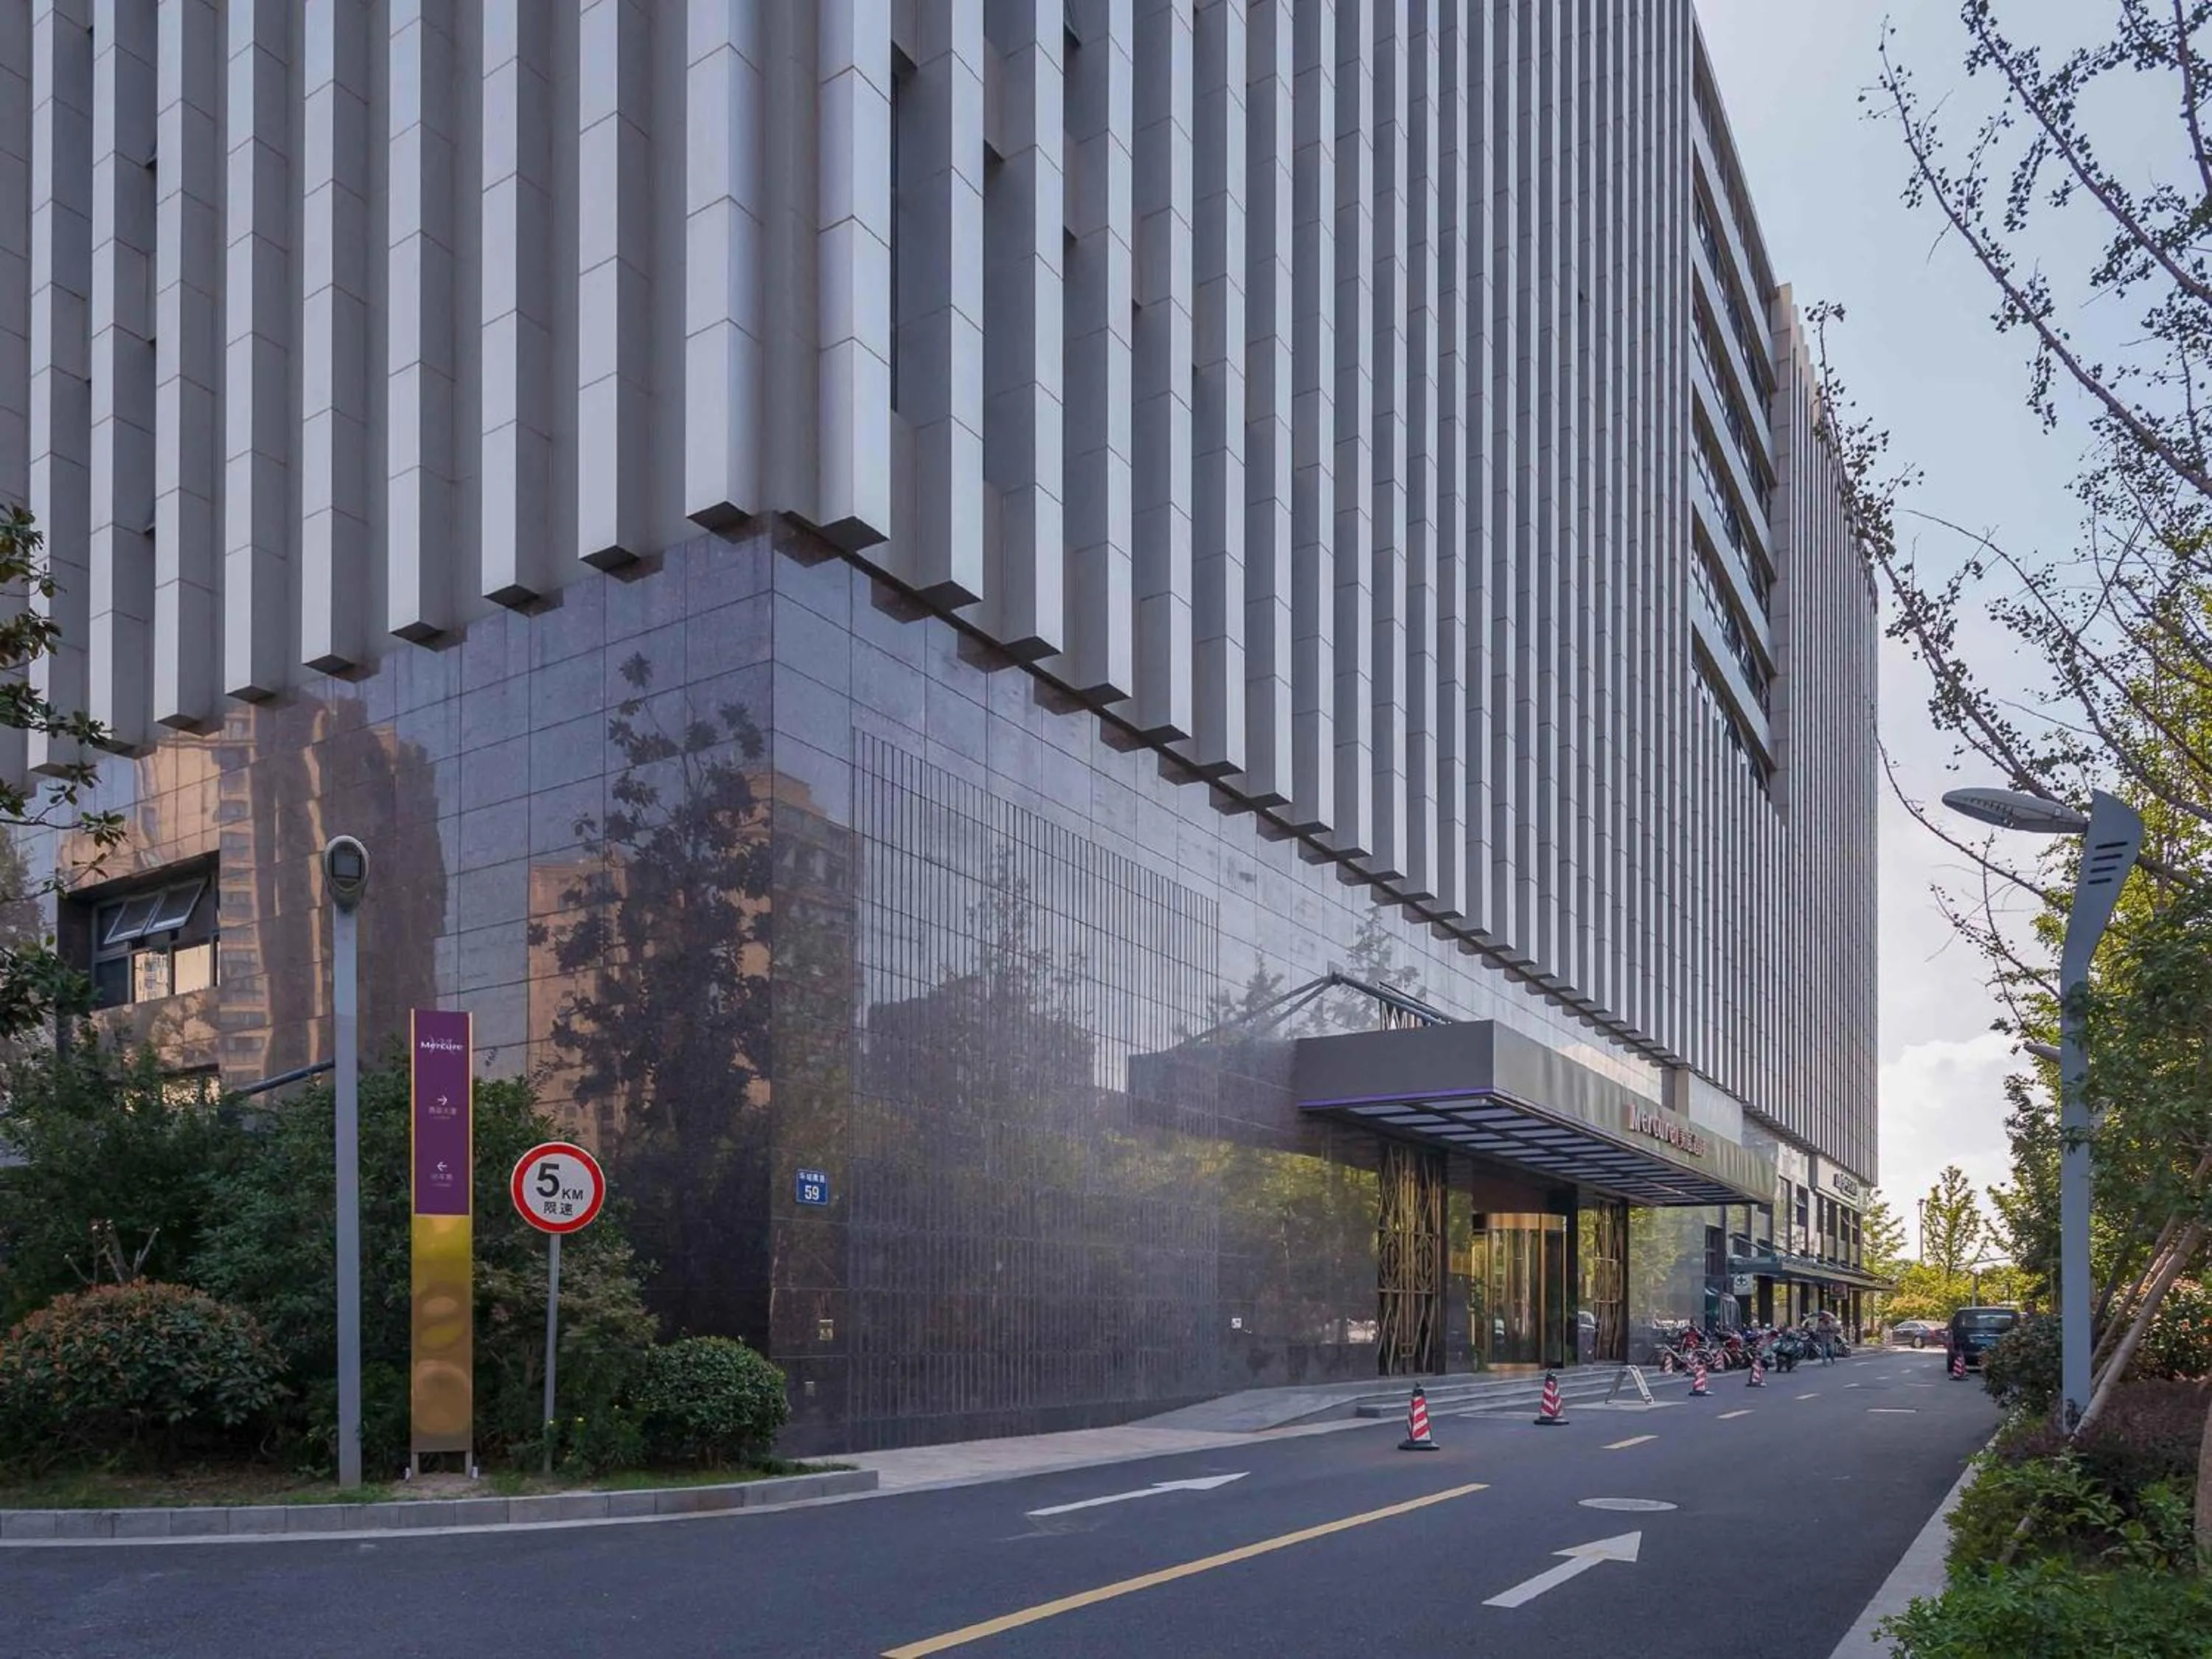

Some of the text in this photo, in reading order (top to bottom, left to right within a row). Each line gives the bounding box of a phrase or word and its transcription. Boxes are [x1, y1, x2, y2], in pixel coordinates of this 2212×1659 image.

[420, 1039, 463, 1051] Mercure
[804, 1185, 819, 1200] 59
[543, 1201, 573, 1215] 限速
